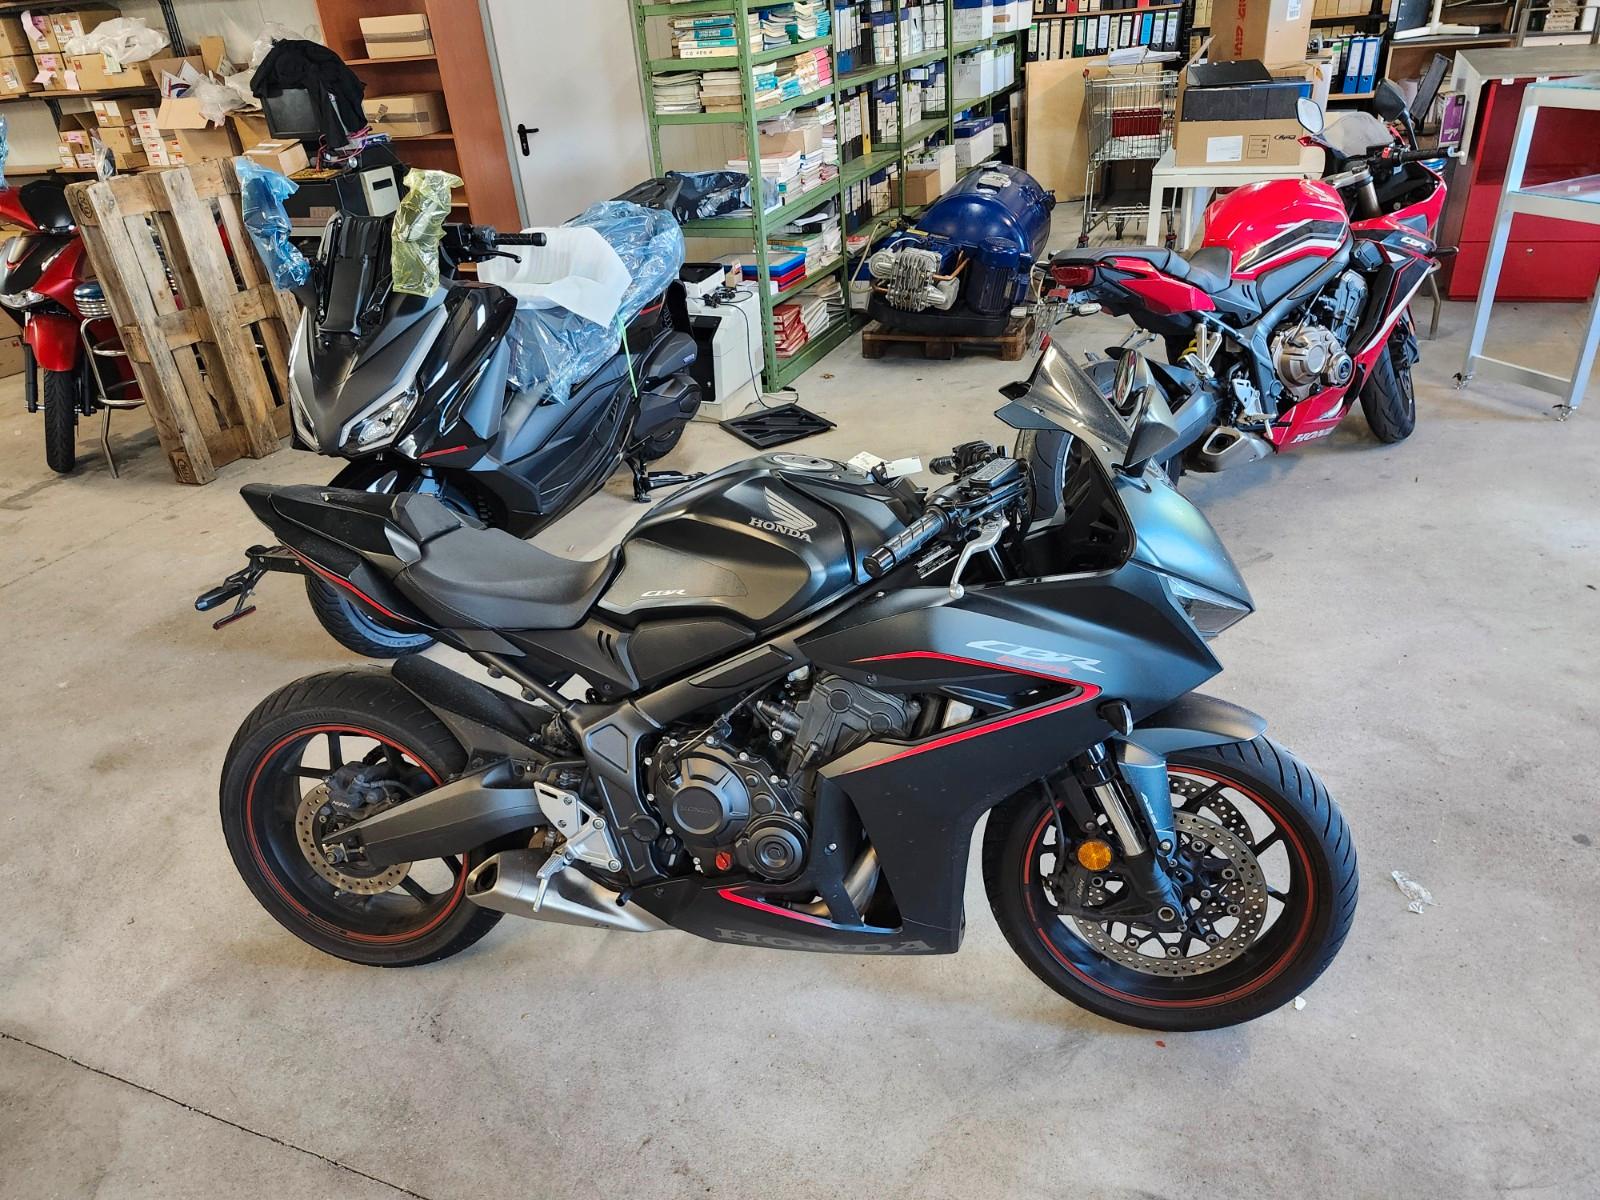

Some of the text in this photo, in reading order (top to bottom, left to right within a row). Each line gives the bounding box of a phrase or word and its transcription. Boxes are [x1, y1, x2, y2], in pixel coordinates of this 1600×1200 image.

[748, 516, 812, 543] HONDA
[641, 588, 687, 597] CBR
[965, 640, 1105, 674] CBR
[714, 927, 938, 952] HONDA
